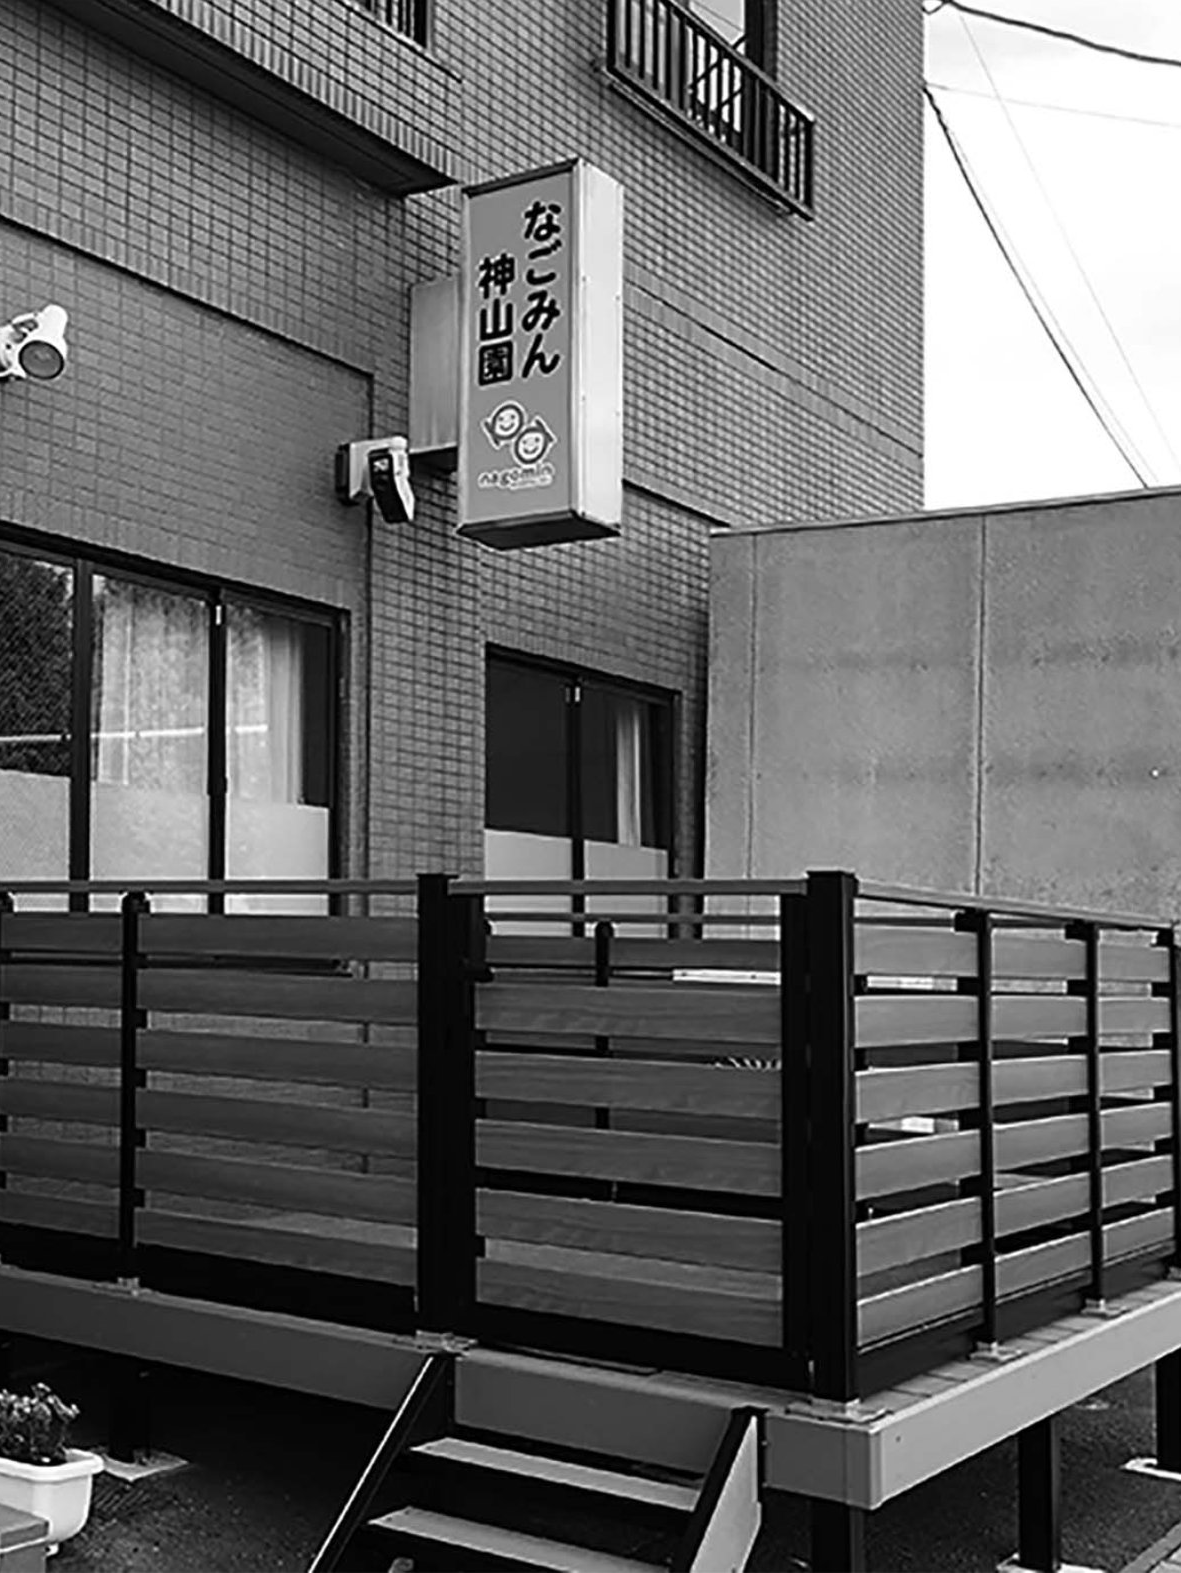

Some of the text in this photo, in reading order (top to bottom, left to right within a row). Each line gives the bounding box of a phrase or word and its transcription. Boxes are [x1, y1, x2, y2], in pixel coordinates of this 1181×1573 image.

[478, 253, 514, 386] 神山園
[522, 201, 561, 379] なごみん
